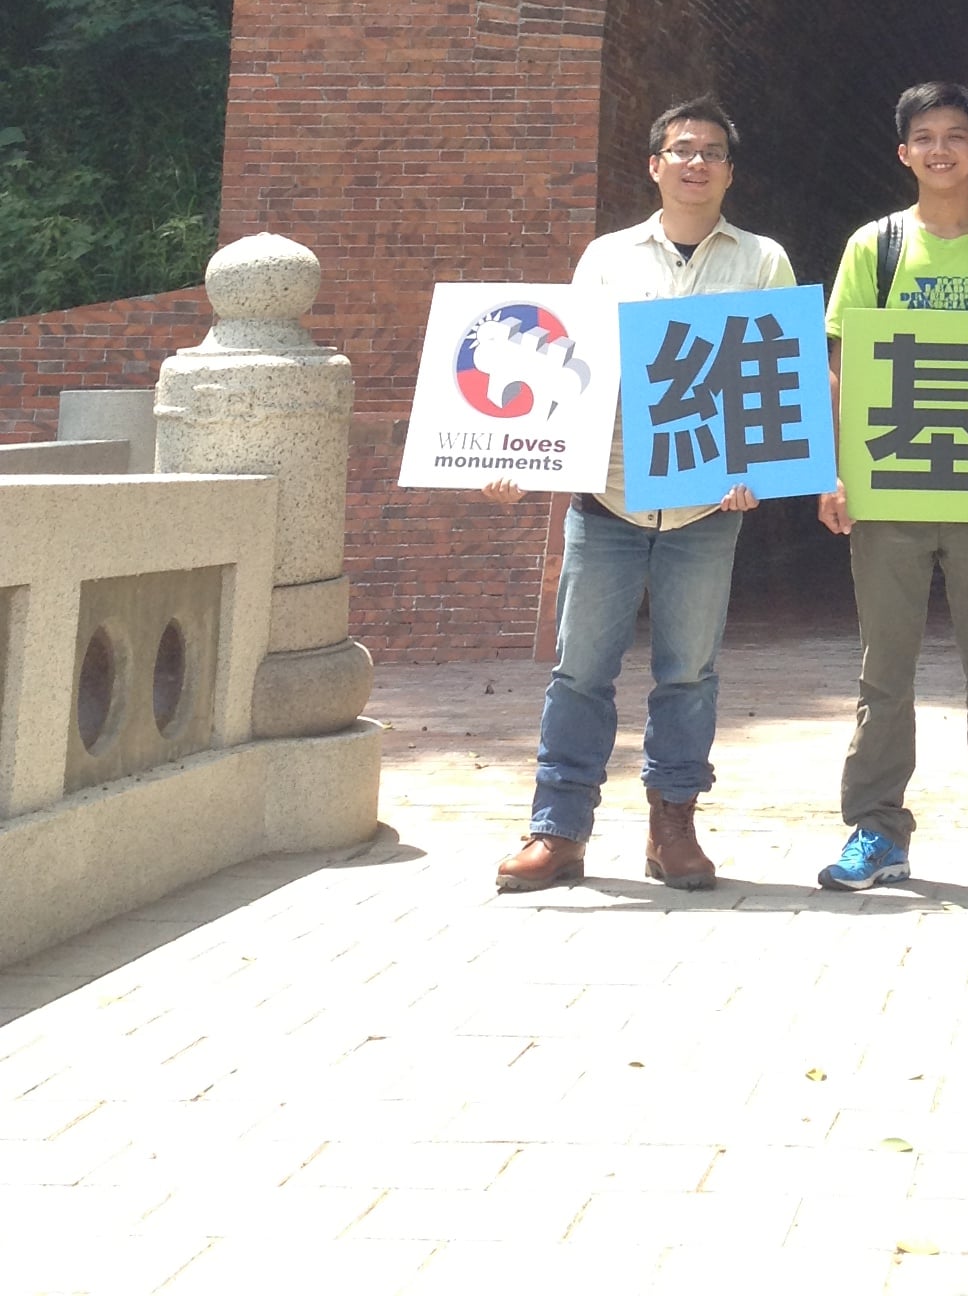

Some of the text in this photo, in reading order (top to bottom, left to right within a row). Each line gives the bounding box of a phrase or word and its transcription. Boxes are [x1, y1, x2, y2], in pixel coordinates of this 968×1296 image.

[646, 314, 810, 477] 維
[438, 431, 567, 453] WIKI loves
[434, 455, 564, 471] monuments
